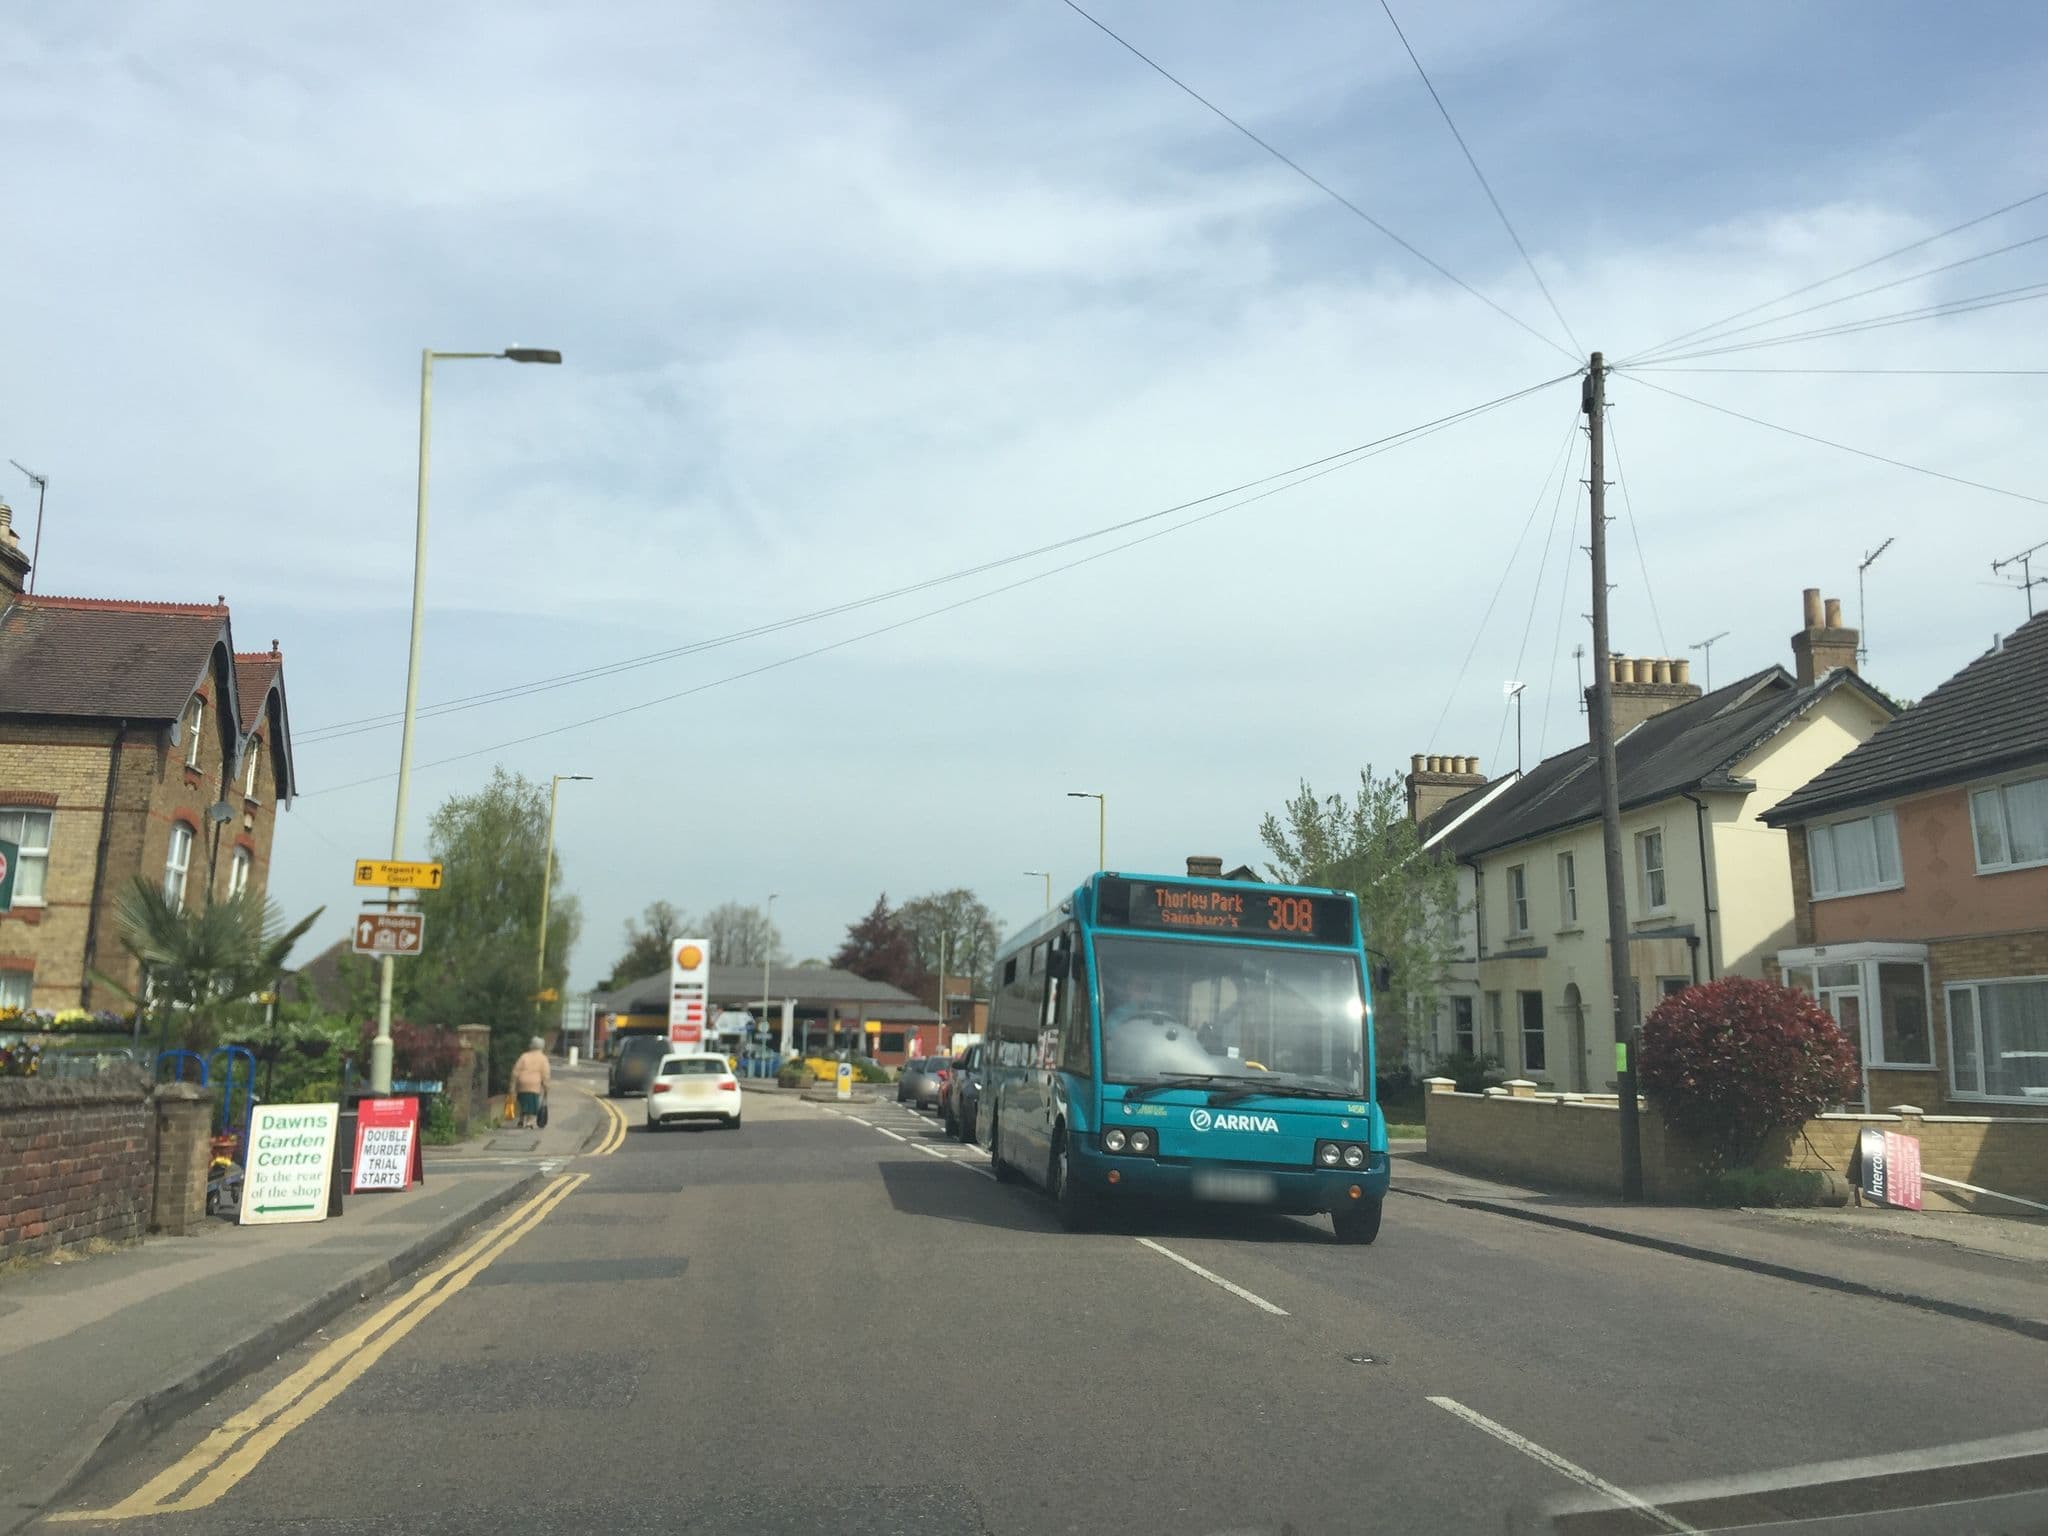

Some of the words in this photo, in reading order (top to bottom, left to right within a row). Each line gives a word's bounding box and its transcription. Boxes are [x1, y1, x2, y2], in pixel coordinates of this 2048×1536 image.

[1155, 888, 1208, 910] Thorley
[1211, 891, 1244, 913] Park
[1160, 909, 1240, 928] Sainsbury's
[1267, 897, 1314, 932] 308
[262, 1115, 328, 1130] Dawns
[1214, 1117, 1279, 1133] ARRIVA
[258, 1134, 325, 1149] Garden
[366, 1130, 408, 1142] DOUBLE
[363, 1144, 407, 1156] MURDER
[258, 1152, 321, 1167] Centre
[368, 1158, 398, 1170] TRIAL
[1866, 1131, 1884, 1197] Intercouy
[272, 1170, 291, 1182] the
[296, 1171, 323, 1182] rear
[361, 1172, 401, 1184] STARTS
[251, 1187, 265, 1199] of
[268, 1186, 287, 1198] the
[292, 1184, 322, 1199] shop
